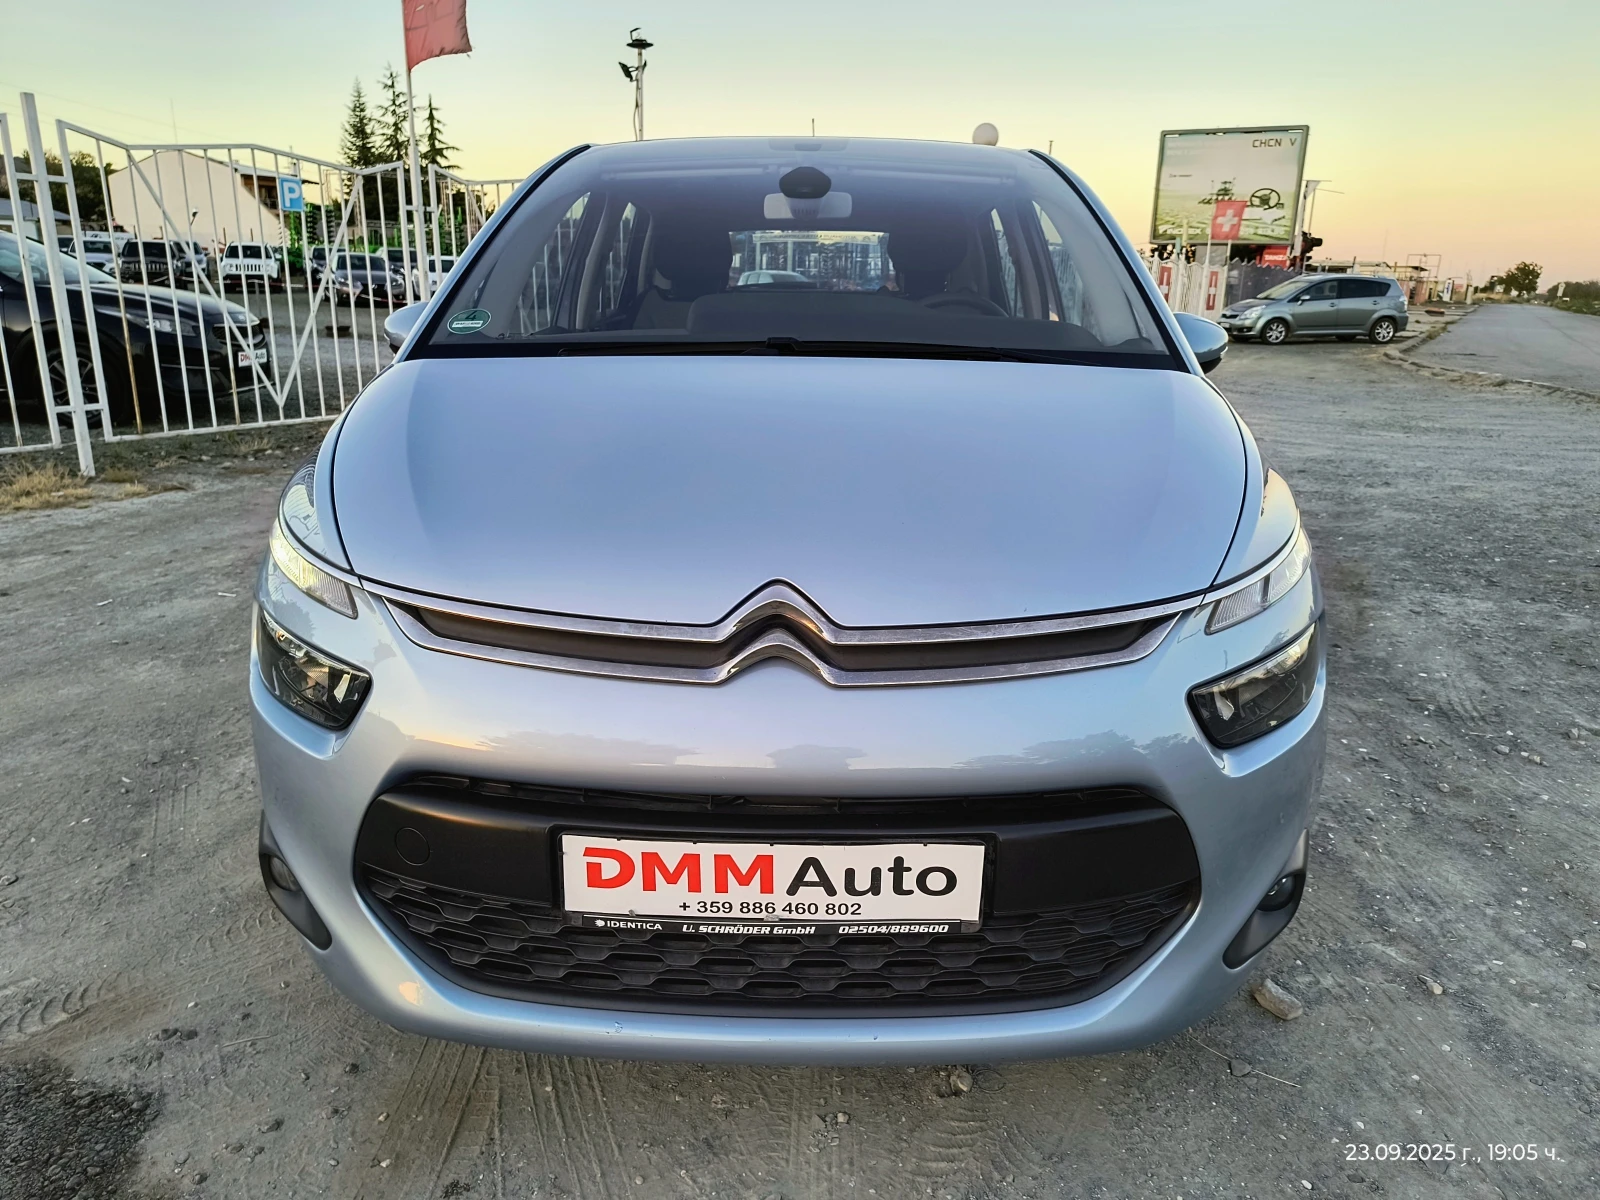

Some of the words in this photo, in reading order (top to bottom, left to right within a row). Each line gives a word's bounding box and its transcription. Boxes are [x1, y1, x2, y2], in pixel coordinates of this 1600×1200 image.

[283, 181, 301, 208] P
[464, 310, 478, 321] 4
[696, 901, 733, 914] 359
[739, 901, 776, 914] 886
[781, 902, 819, 915] 460
[825, 902, 862, 916] 802
[607, 920, 663, 931] IDENTICA
[698, 924, 770, 935] SCHRÖDER
[773, 926, 816, 935] GmbH
[838, 924, 949, 935] 02504/889600
